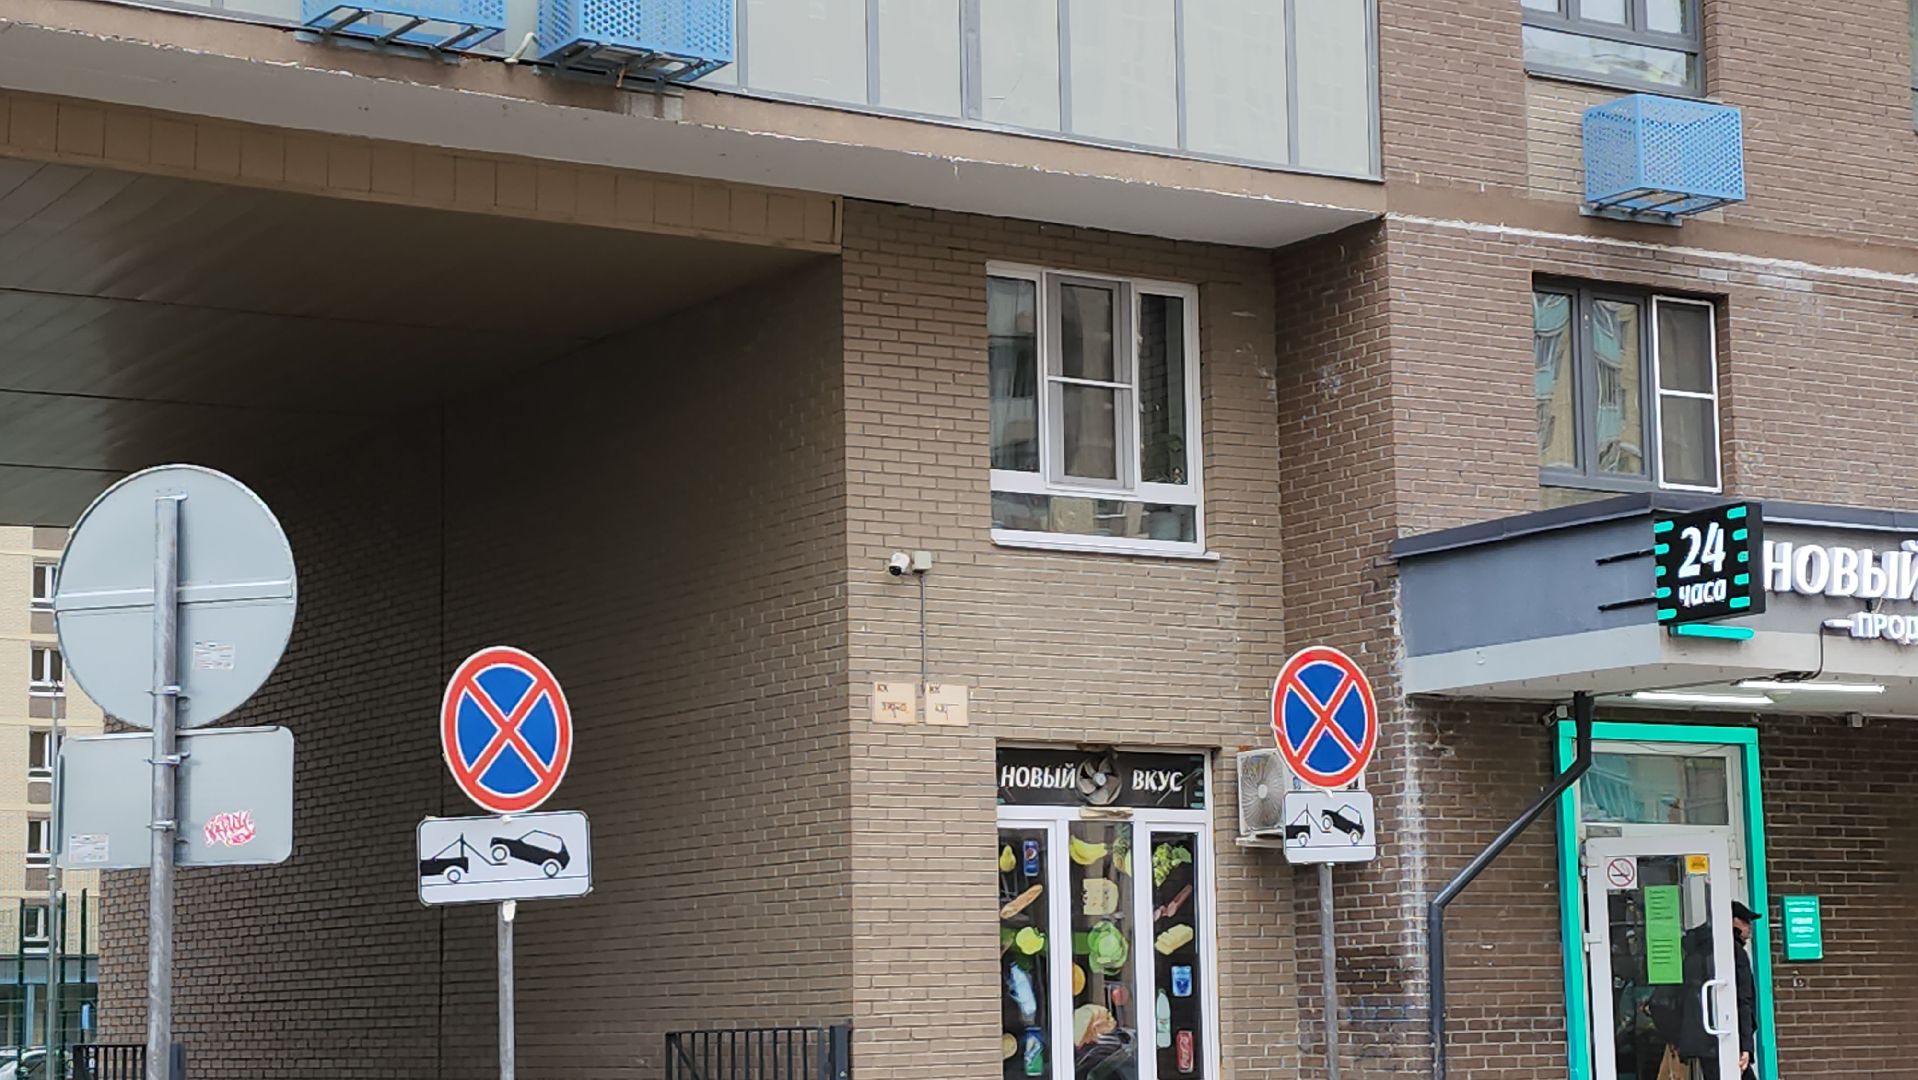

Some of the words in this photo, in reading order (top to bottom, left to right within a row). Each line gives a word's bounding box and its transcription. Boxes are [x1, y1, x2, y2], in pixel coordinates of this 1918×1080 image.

[1678, 522, 1726, 579] 24
[1679, 579, 1727, 608] часа
[1000, 763, 1077, 789] НОВЫЙ
[1132, 769, 1184, 792] ВКУС
